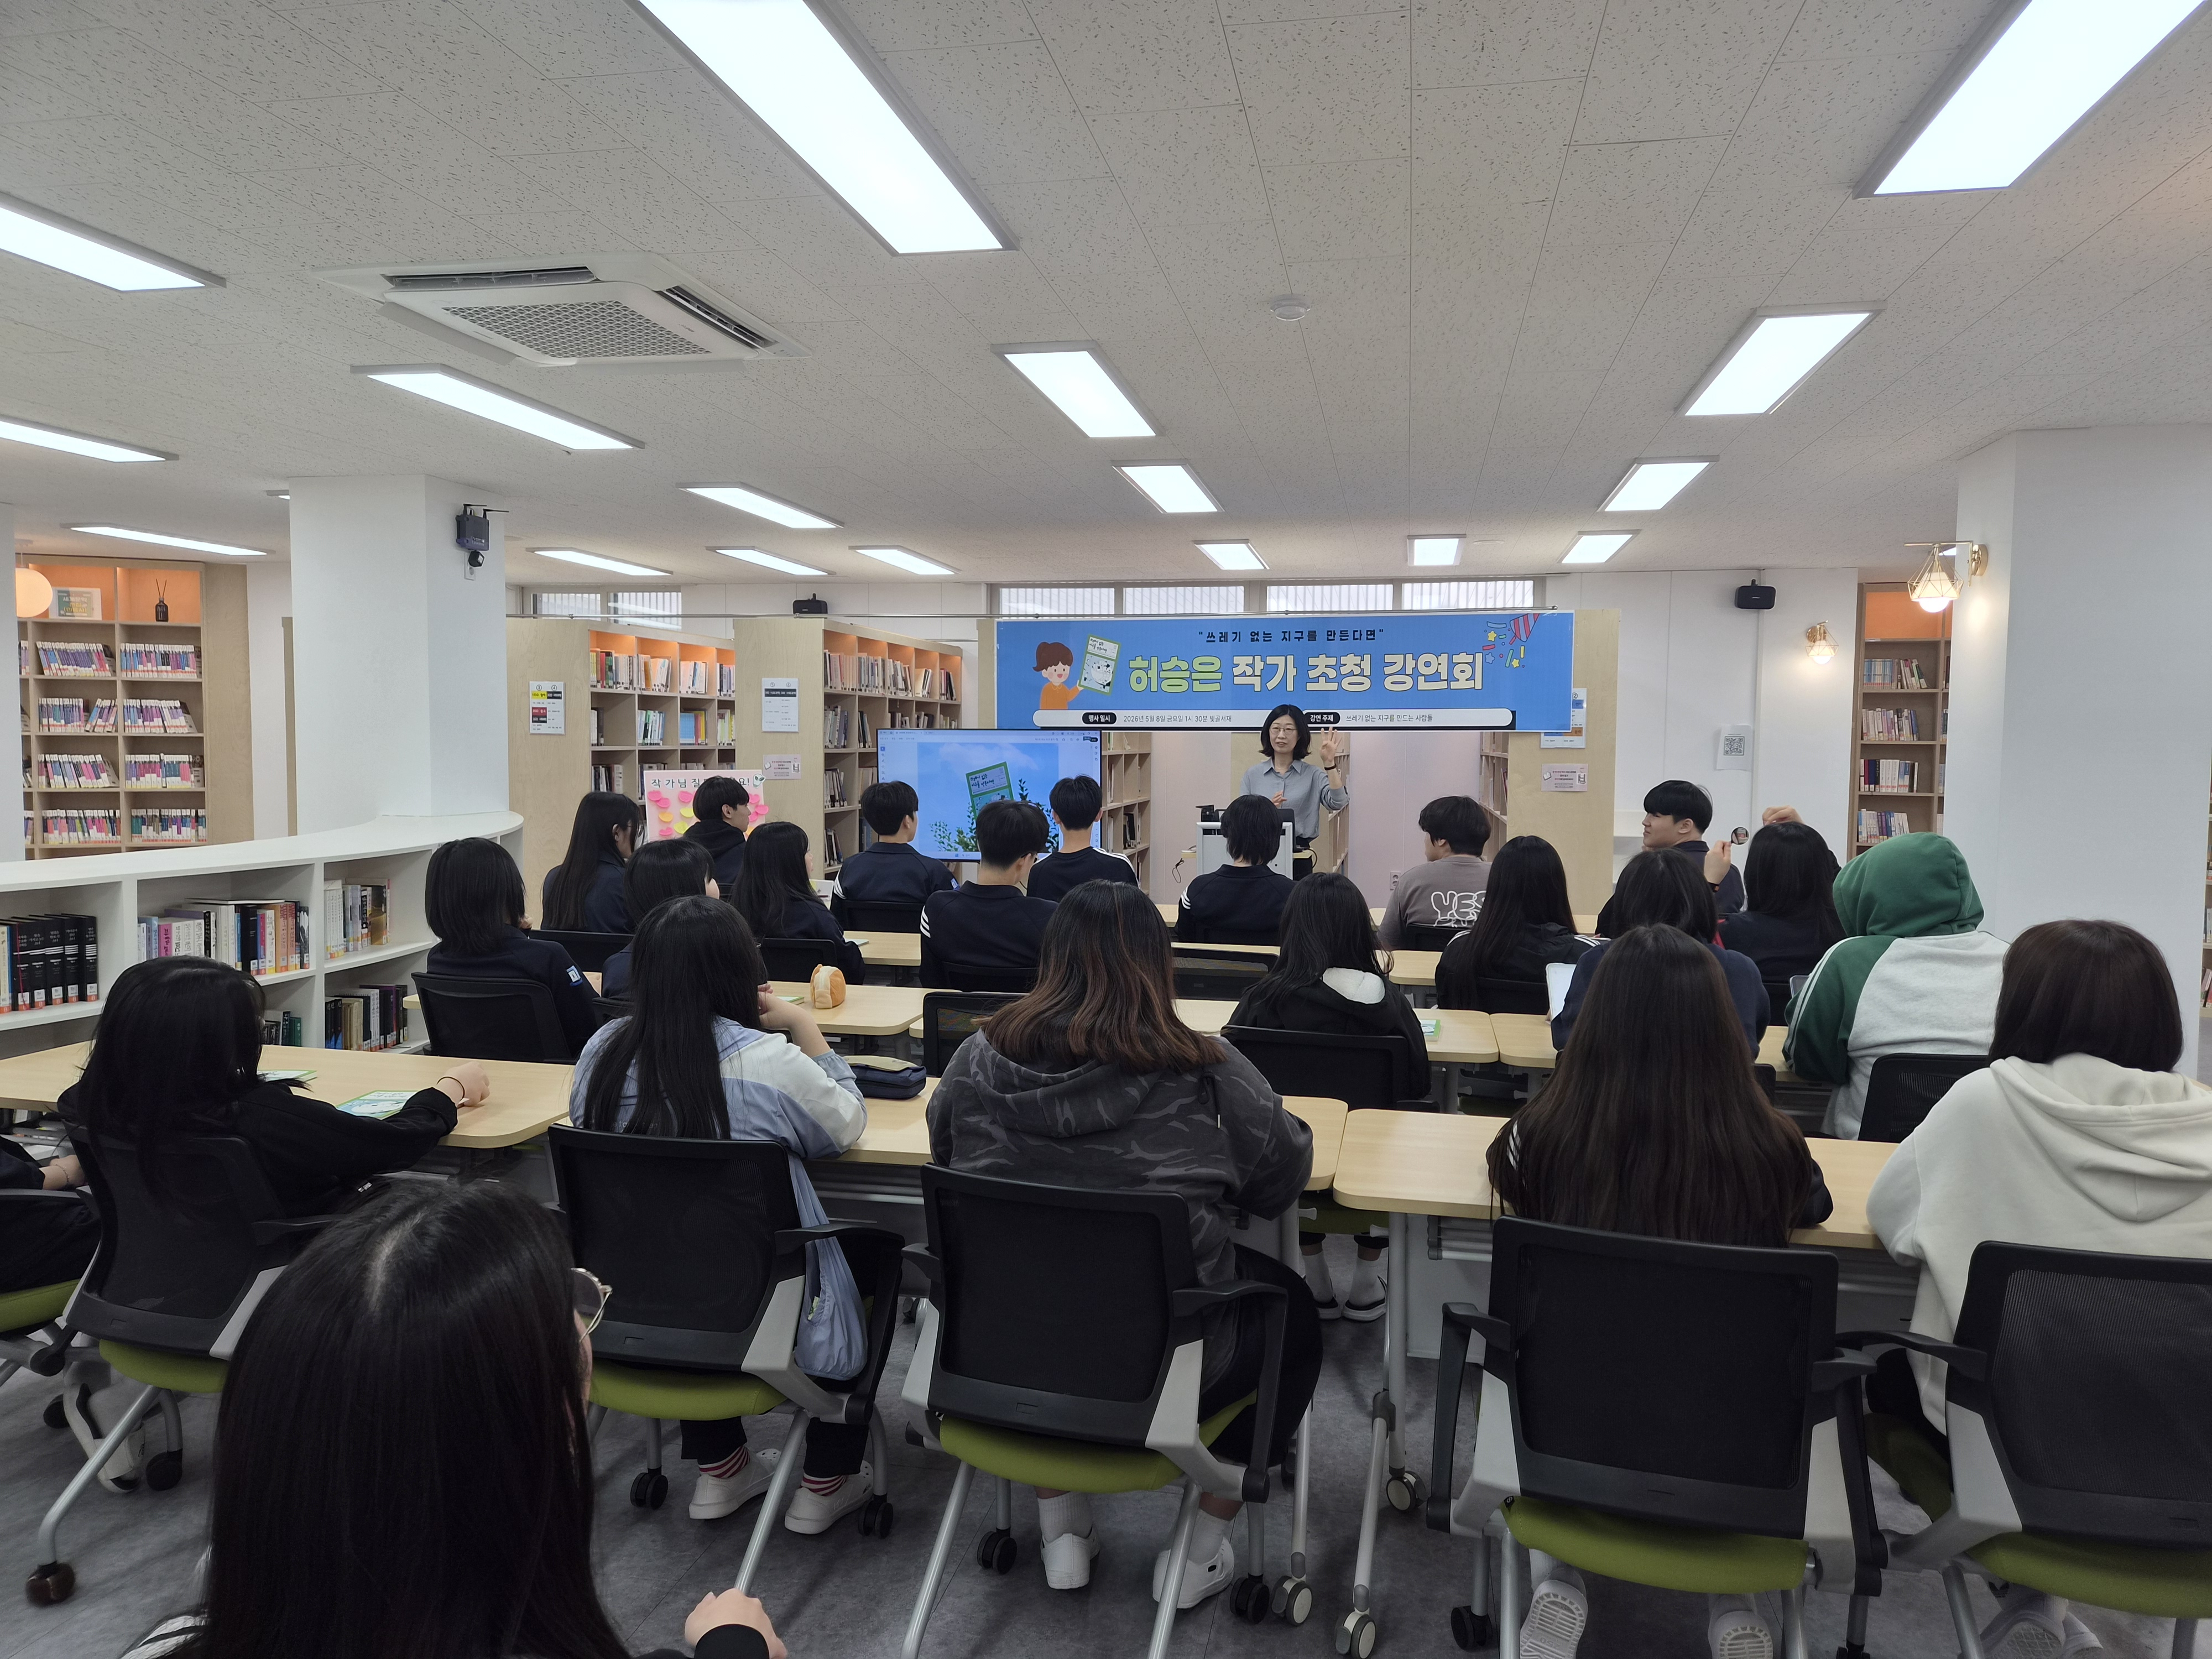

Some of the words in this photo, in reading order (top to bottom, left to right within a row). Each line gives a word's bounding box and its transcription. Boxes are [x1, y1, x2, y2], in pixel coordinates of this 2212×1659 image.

[1250, 630, 1272, 642] 없는
[1281, 630, 1317, 642] 지구를
[1128, 655, 1223, 693] 허승은
[1232, 654, 1297, 692] 작가
[1305, 653, 1371, 692] 초청
[1383, 652, 1483, 692] 강연회
[1310, 714, 1322, 722] 강연
[1322, 714, 1334, 722] 주제
[1364, 714, 1376, 722] 없는
[1378, 714, 1395, 722] 지구를
[1396, 714, 1414, 722] 만드는
[1415, 714, 1433, 722] 사람들
[651, 778, 687, 789] 작가님
